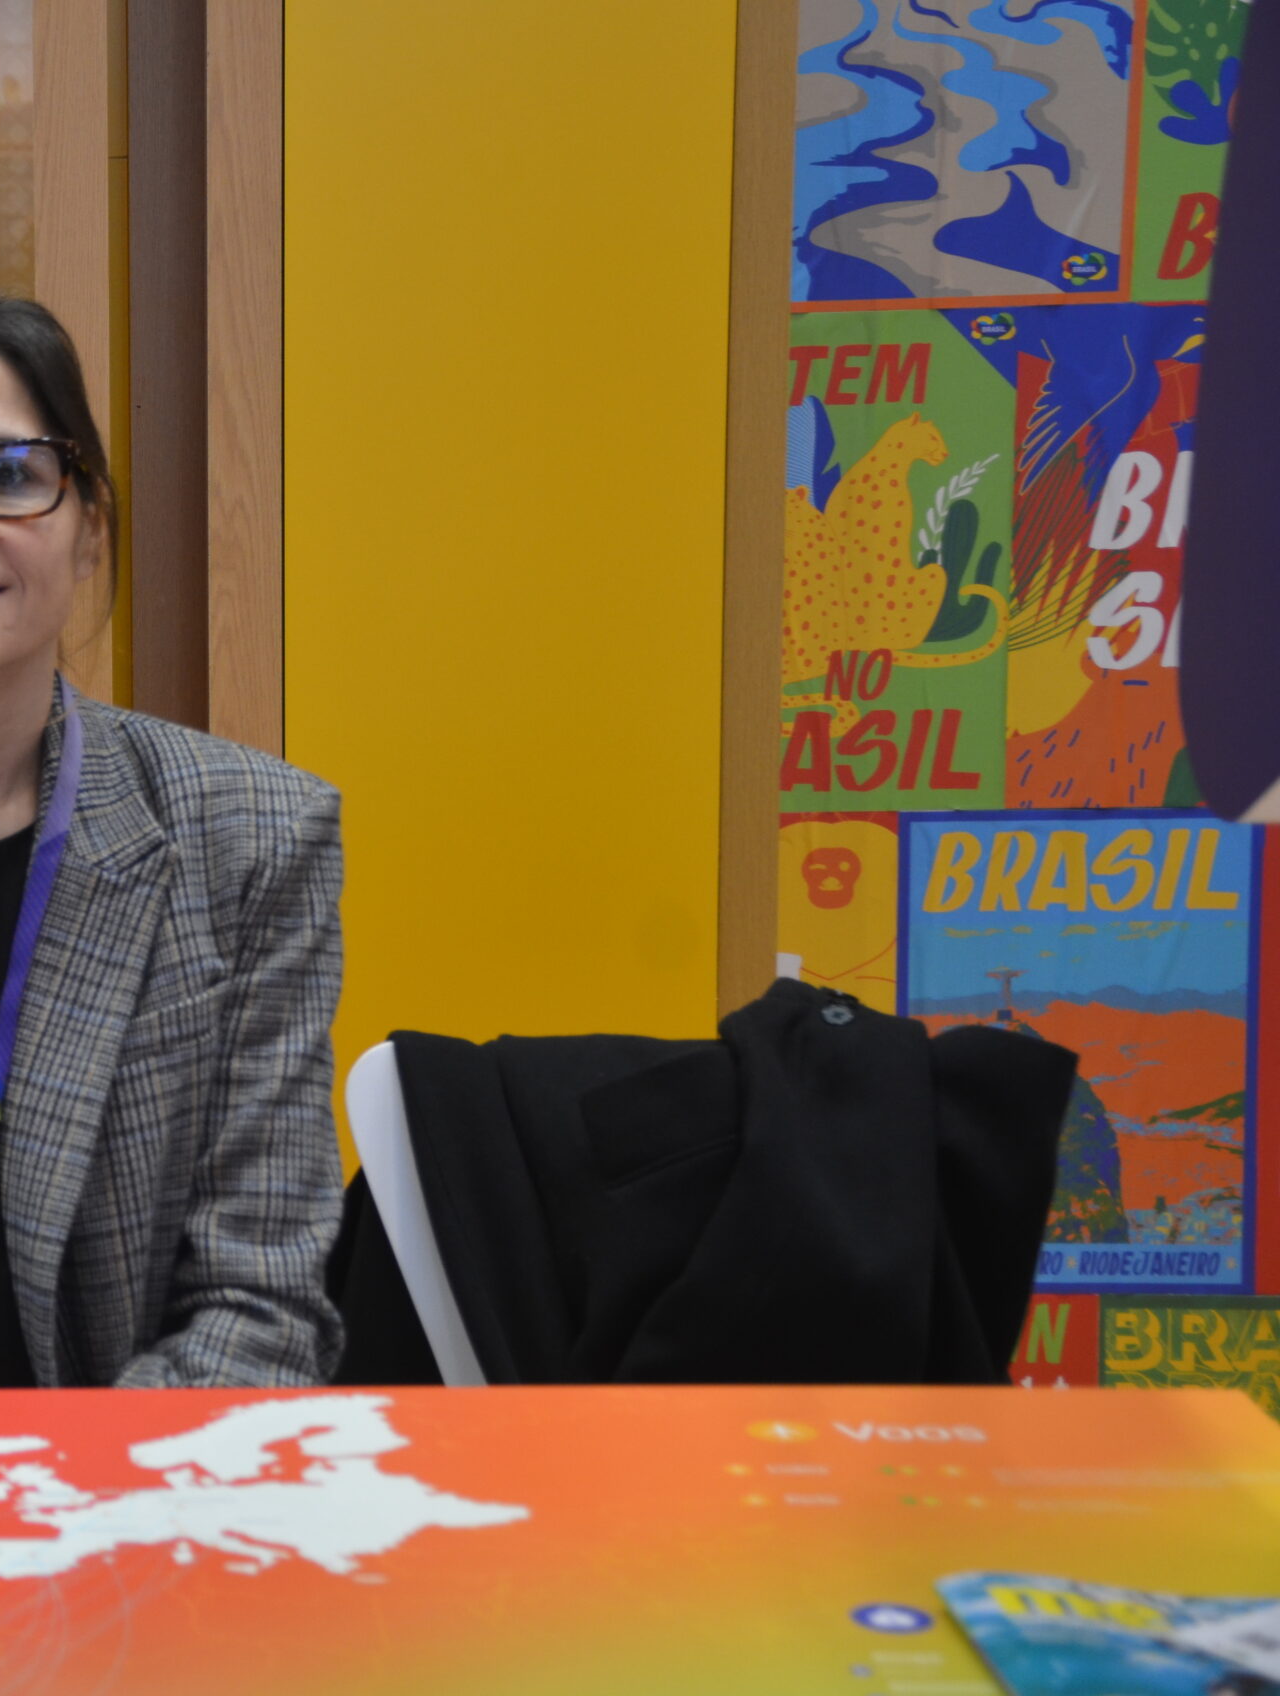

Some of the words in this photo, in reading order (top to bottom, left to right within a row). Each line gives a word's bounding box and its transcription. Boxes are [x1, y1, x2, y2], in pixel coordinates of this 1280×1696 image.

[789, 343, 932, 406] TEM
[1087, 571, 1182, 670] S
[824, 648, 893, 701] NO
[780, 708, 981, 792] ASIL
[922, 829, 1239, 912] BRASIL
[1011, 1303, 1070, 1364] N
